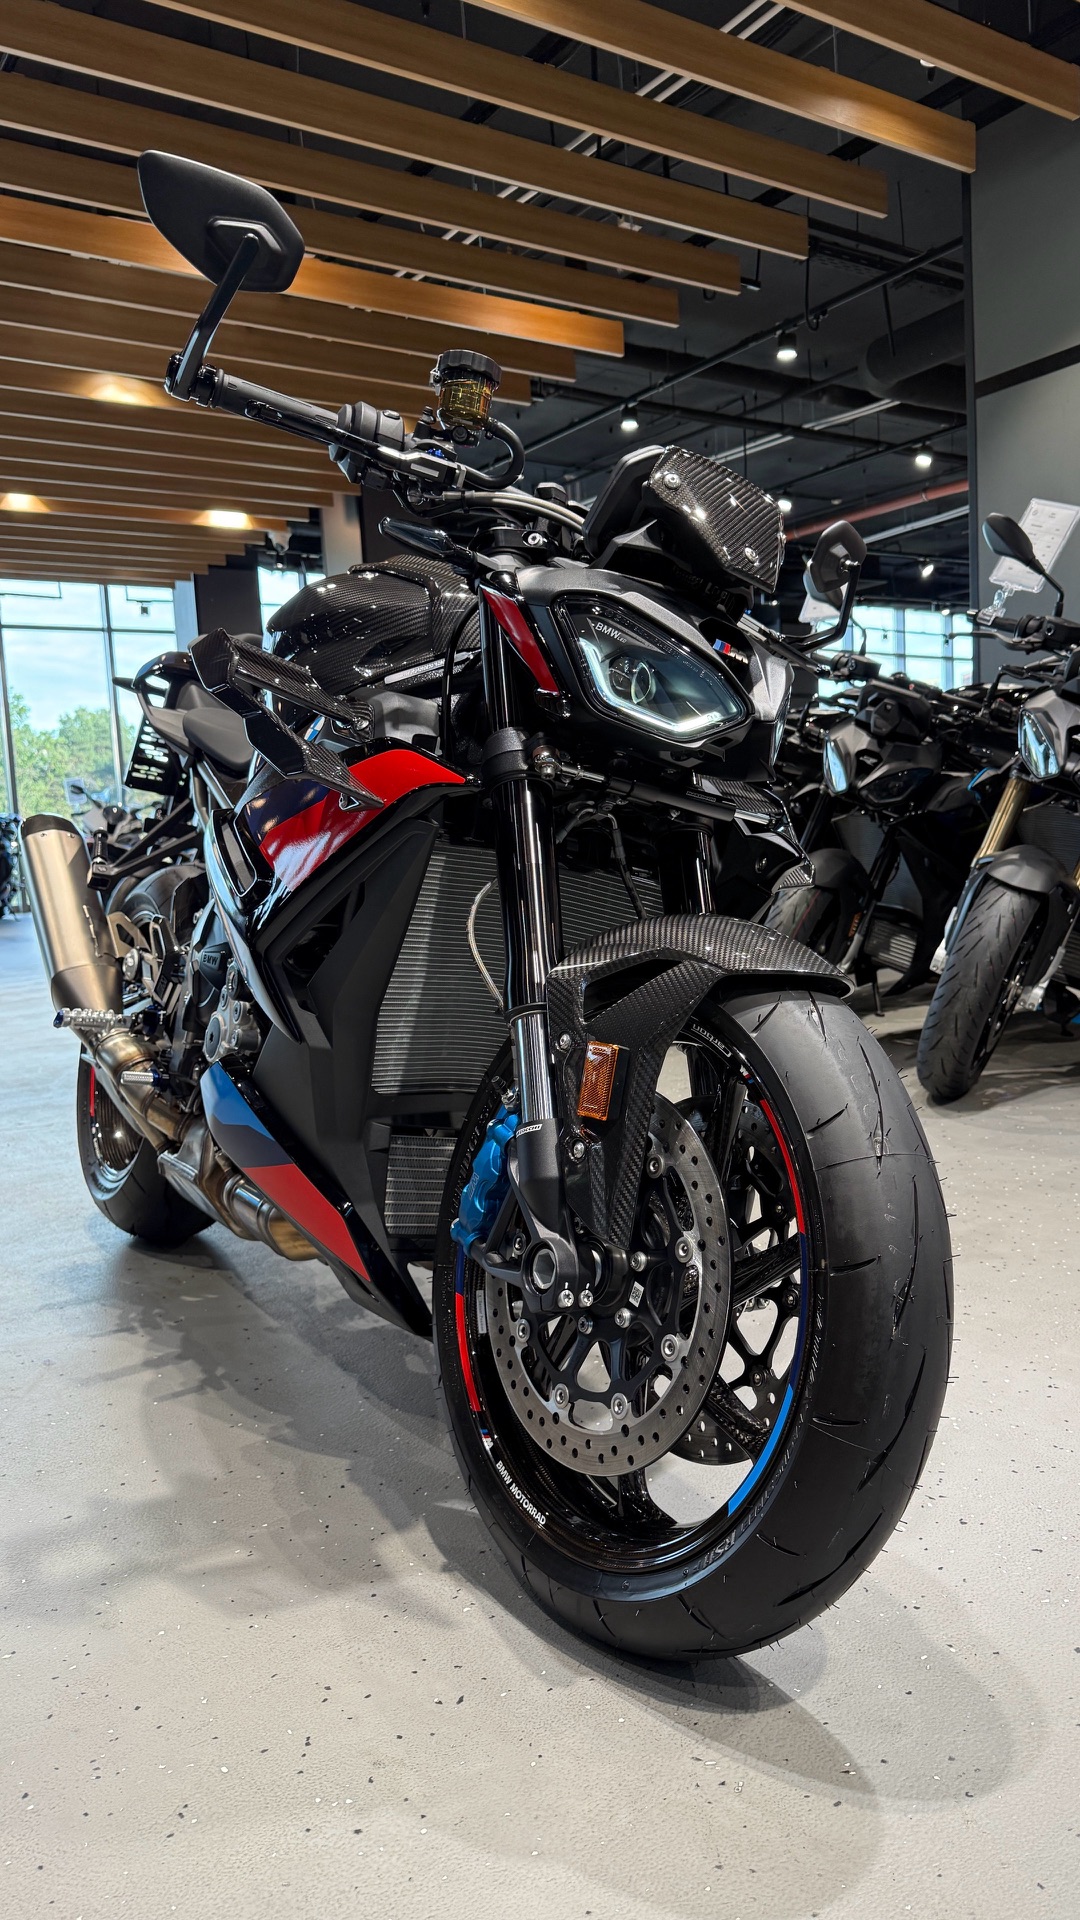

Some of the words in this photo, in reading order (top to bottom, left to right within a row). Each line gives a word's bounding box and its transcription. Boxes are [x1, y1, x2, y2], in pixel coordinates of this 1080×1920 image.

[595, 621, 620, 640] BMW
[203, 954, 218, 966] BMW
[495, 1460, 513, 1486] BMW
[508, 1482, 547, 1526] MOTORRAD
